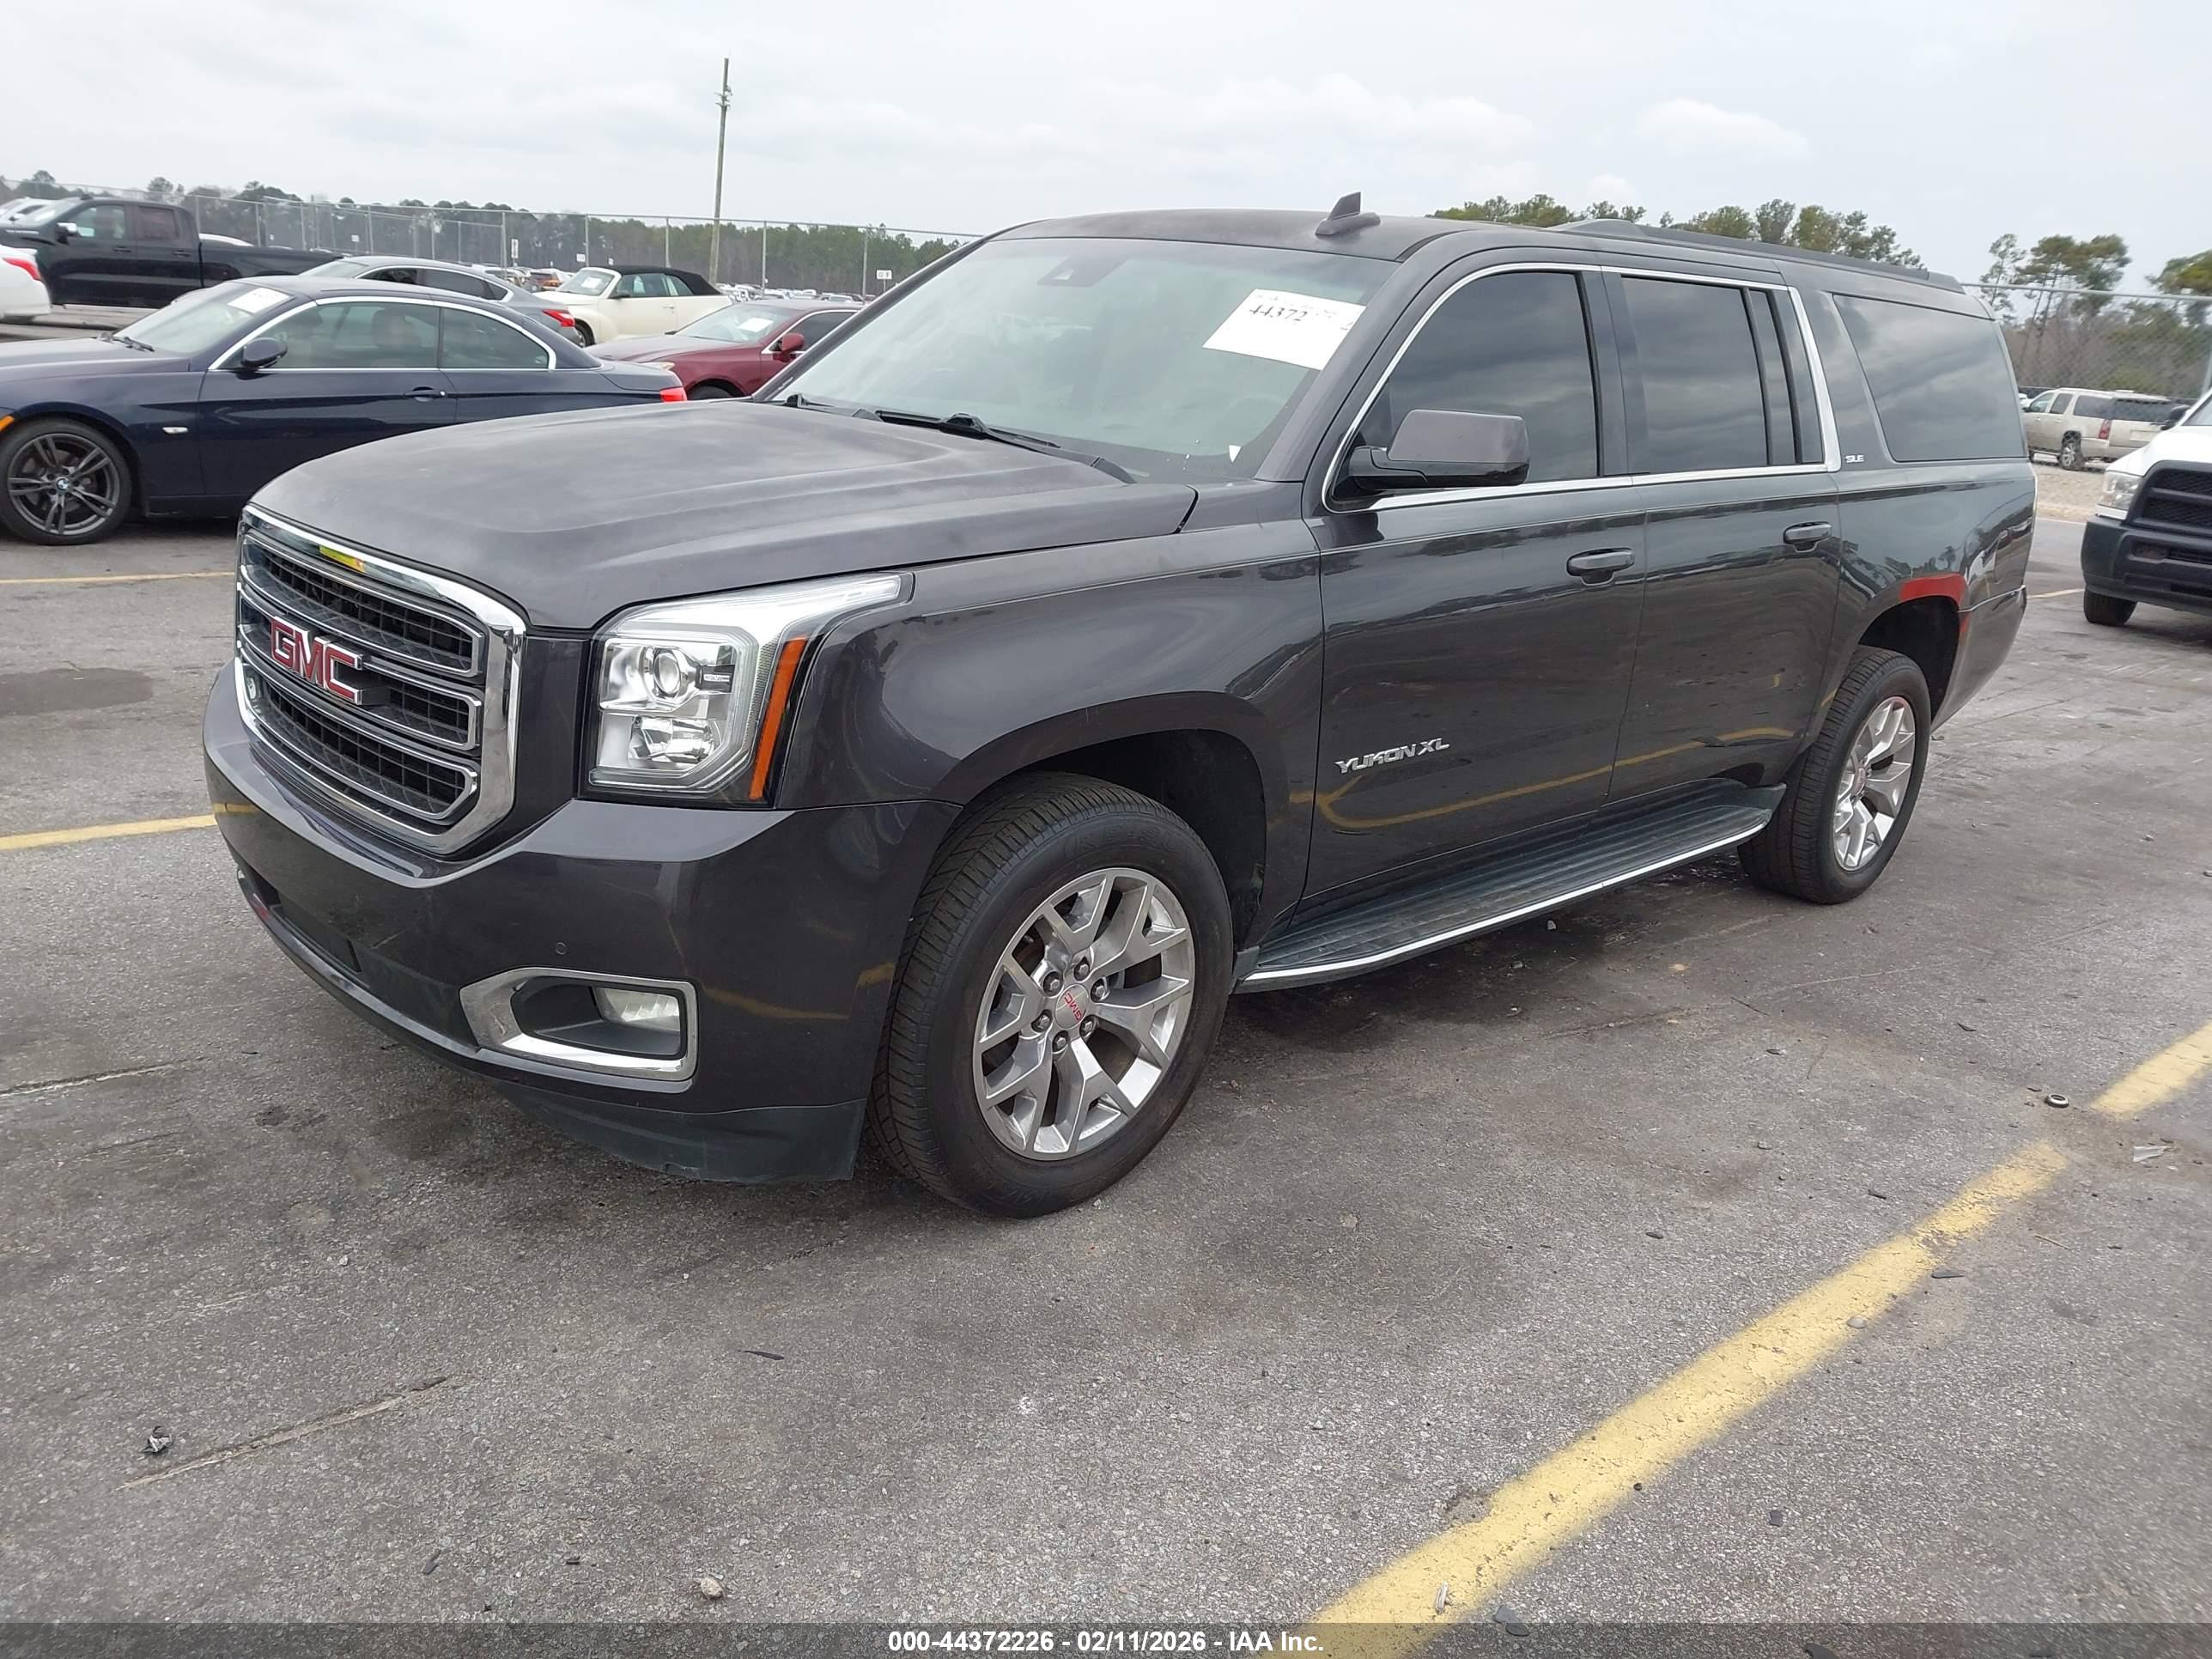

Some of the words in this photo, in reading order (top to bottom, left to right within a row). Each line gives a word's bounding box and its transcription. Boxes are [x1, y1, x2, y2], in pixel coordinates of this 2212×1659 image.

[1845, 454, 1865, 464] SLE
[270, 617, 362, 705] GMC
[1334, 744, 1417, 774] YUKON
[1418, 738, 1450, 756] XL
[1064, 990, 1083, 1023] GMC
